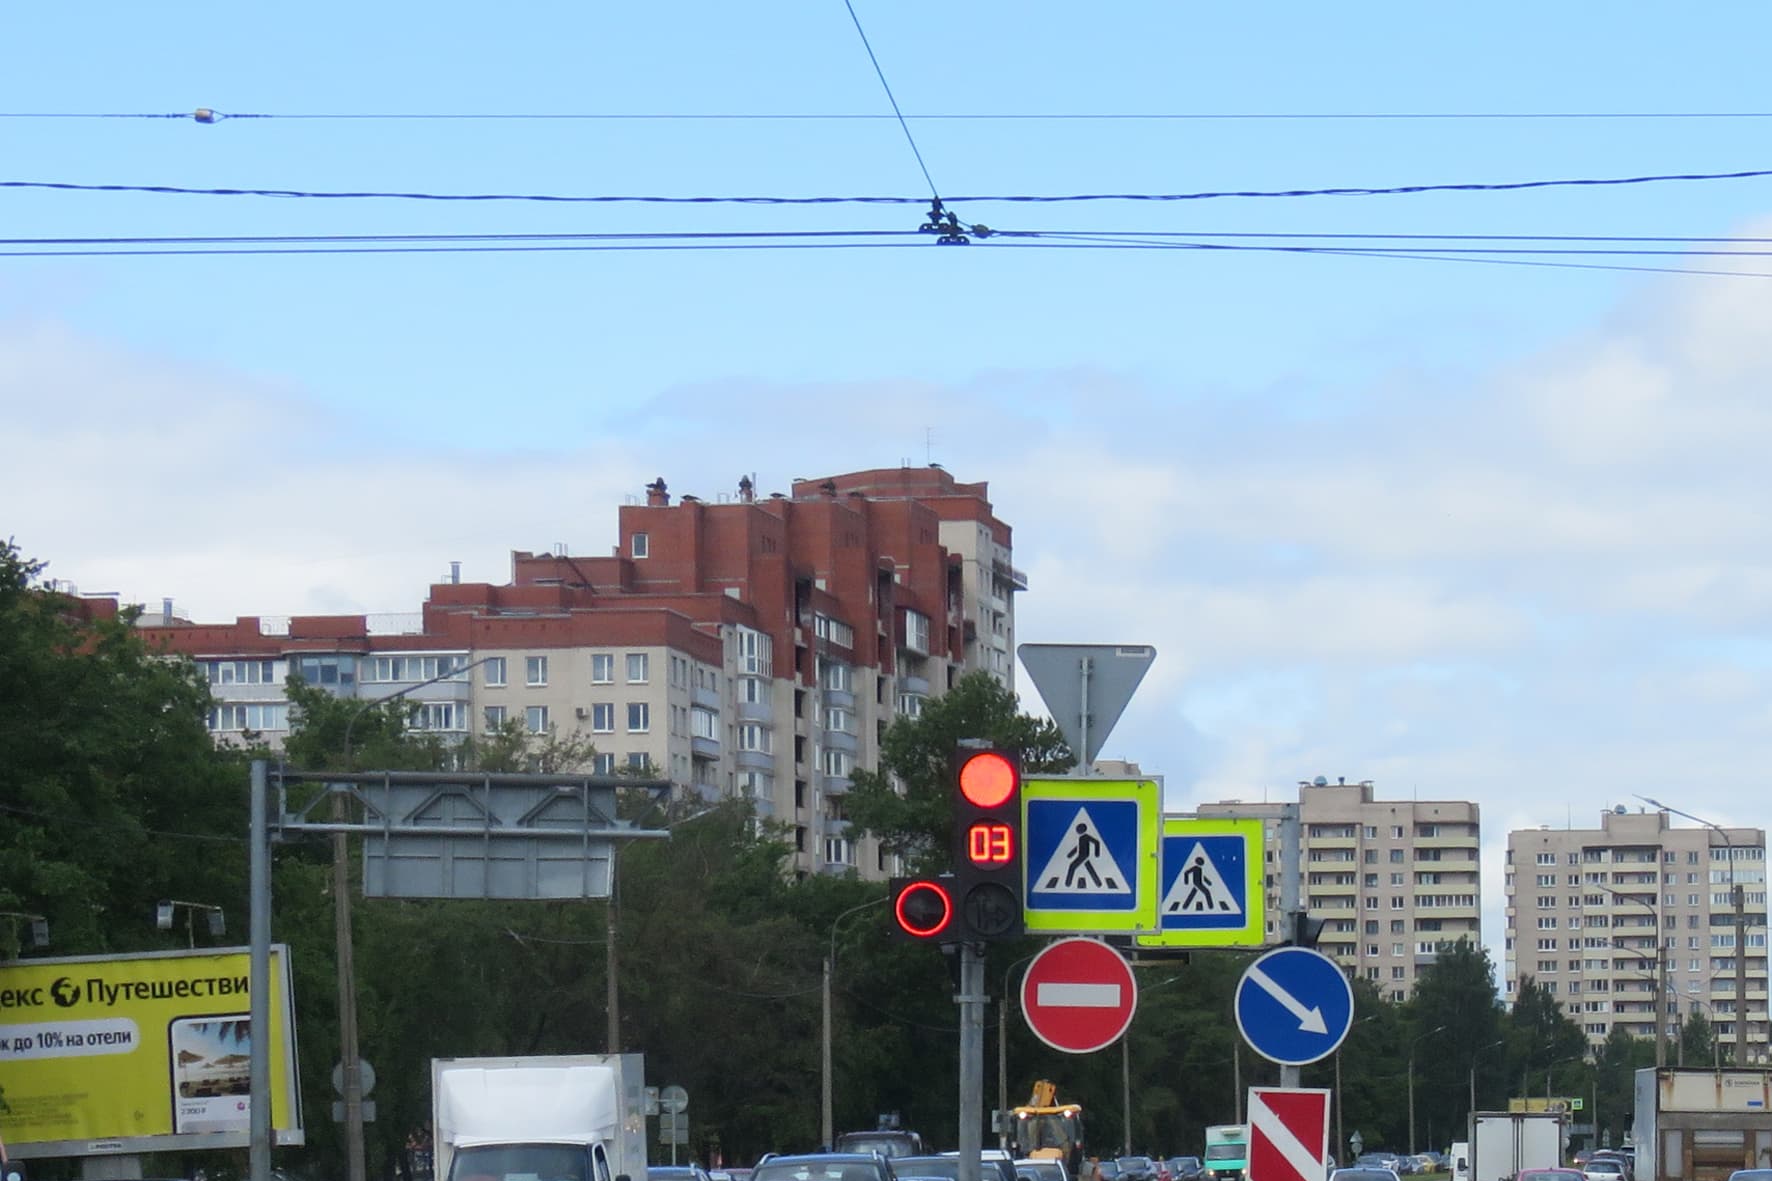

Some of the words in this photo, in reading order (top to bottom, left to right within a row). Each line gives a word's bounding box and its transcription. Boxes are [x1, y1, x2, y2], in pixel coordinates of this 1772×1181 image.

[970, 826, 1010, 861] 03
[0, 987, 44, 1011] екс
[86, 976, 249, 1006] Путешестви
[14, 1037, 33, 1053] до
[37, 1032, 63, 1049] 10%
[66, 1034, 84, 1047] на
[87, 1031, 132, 1047] отели
